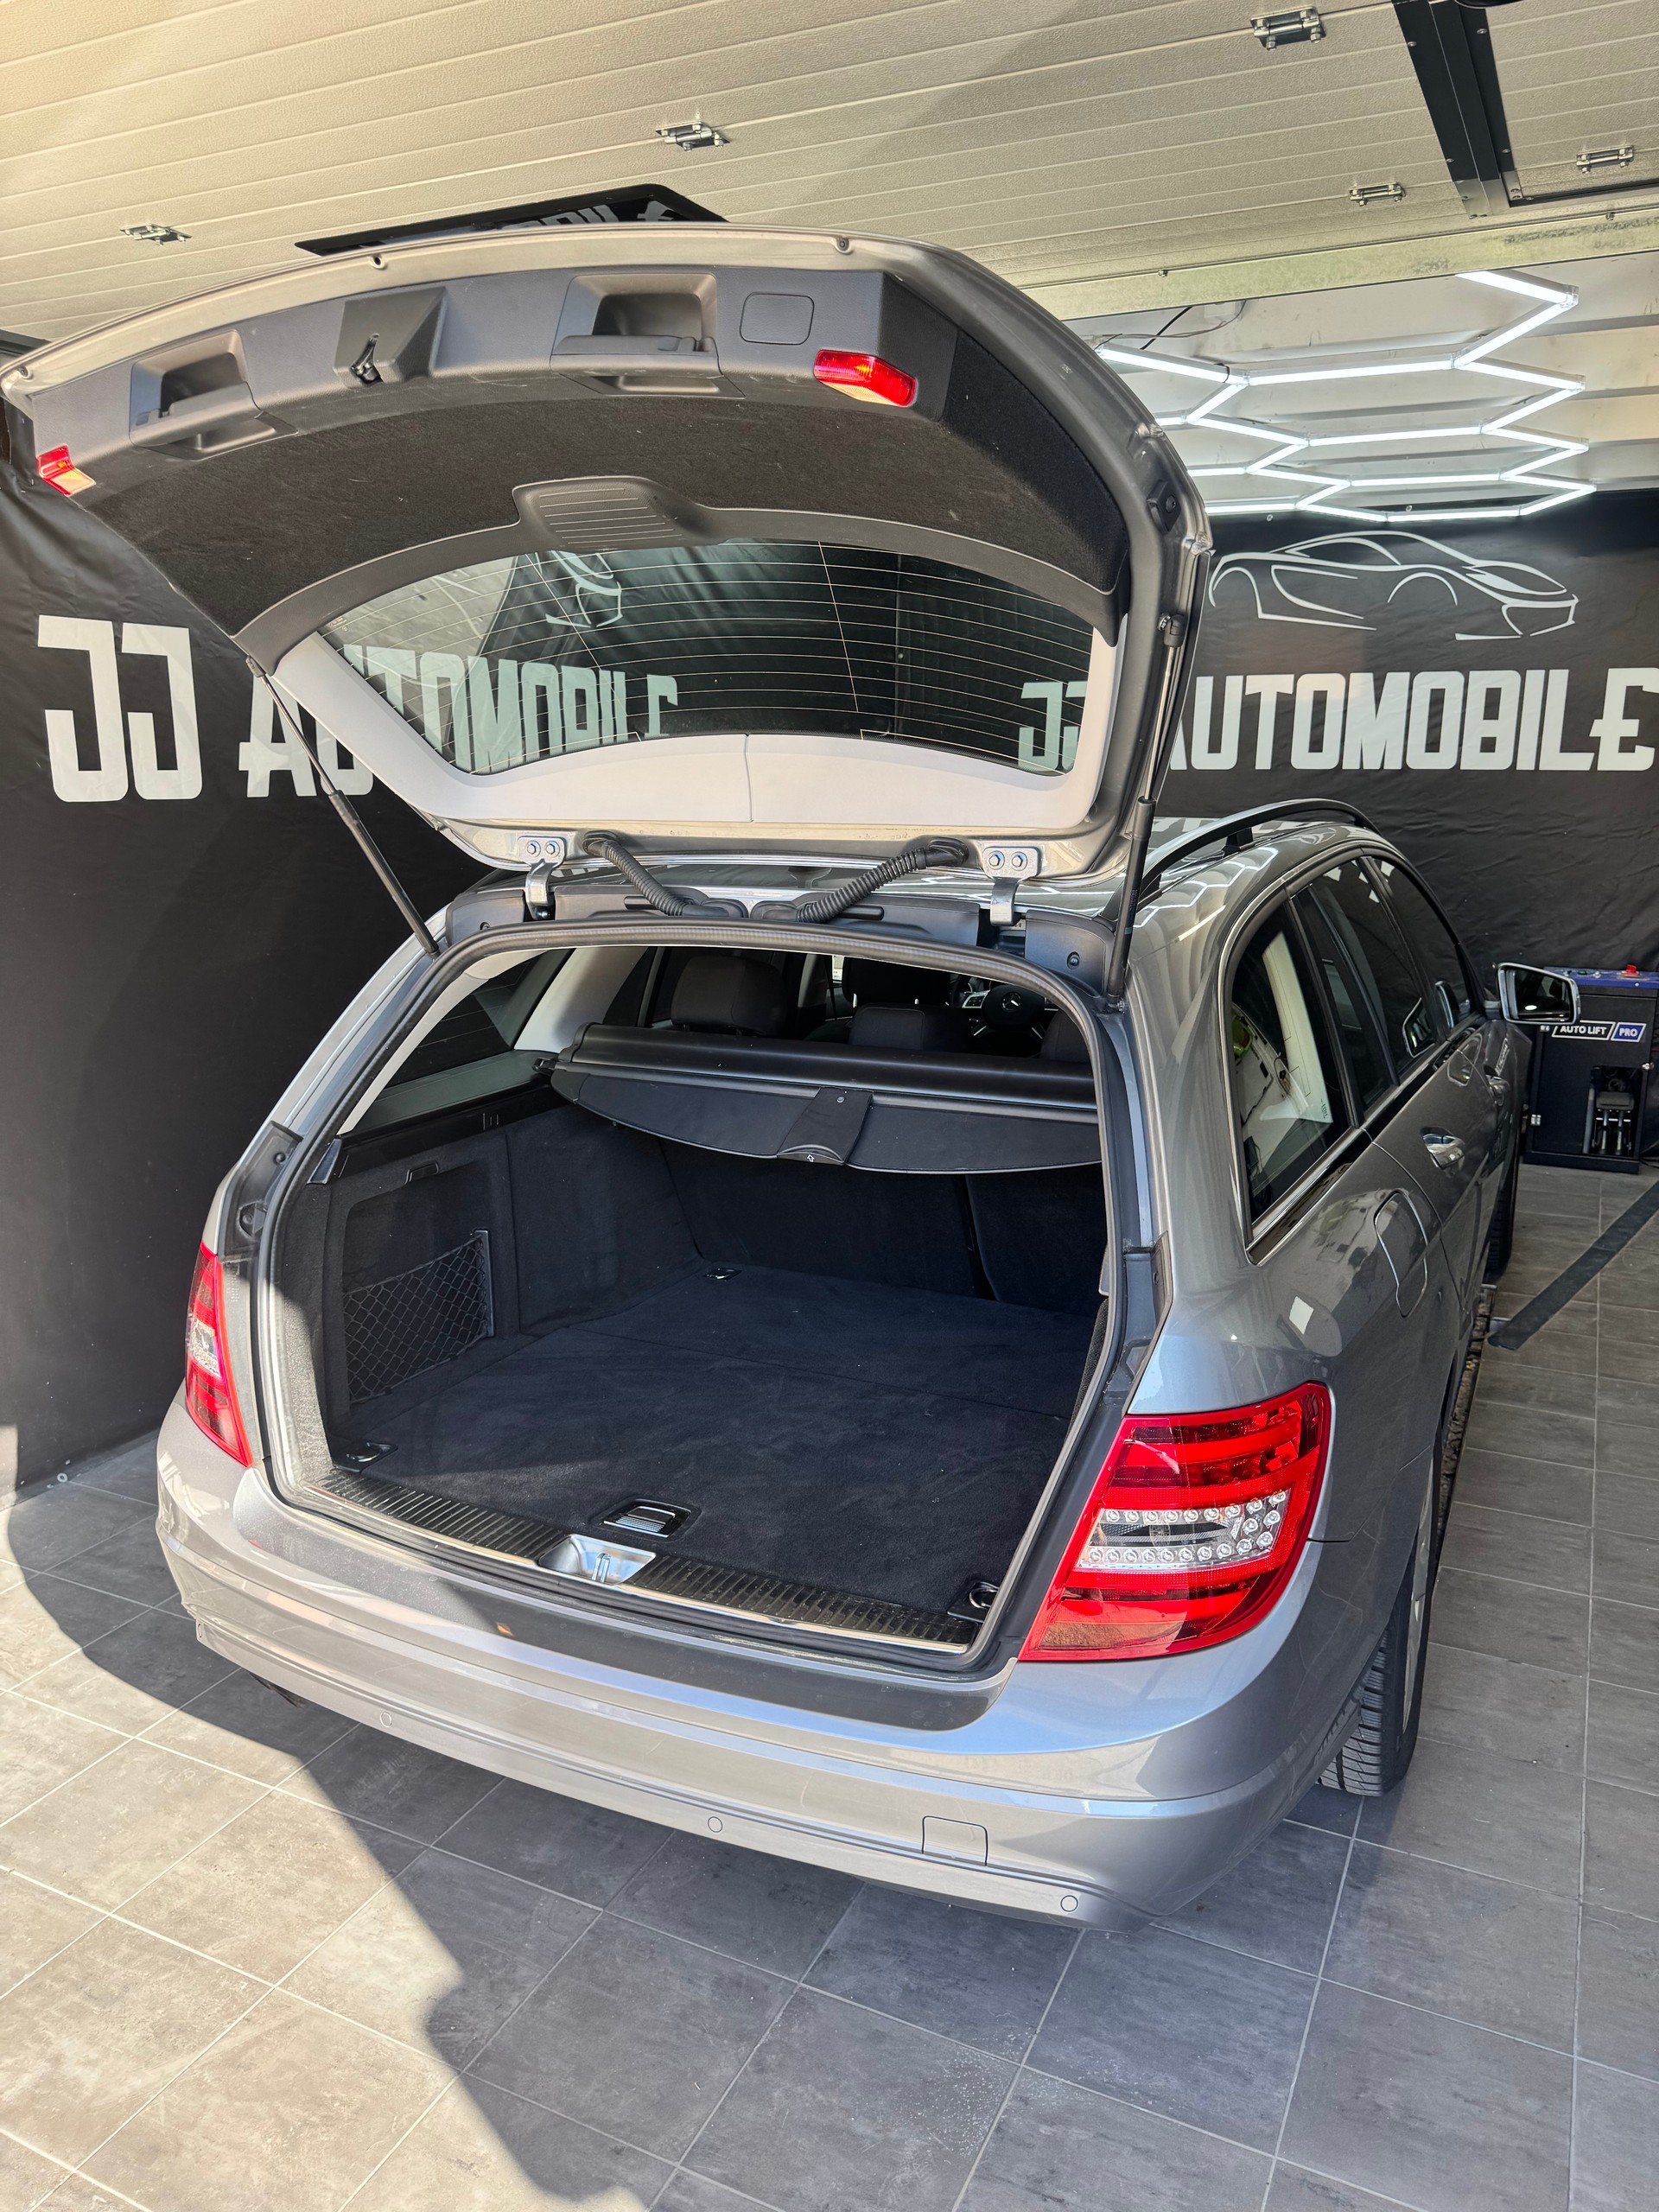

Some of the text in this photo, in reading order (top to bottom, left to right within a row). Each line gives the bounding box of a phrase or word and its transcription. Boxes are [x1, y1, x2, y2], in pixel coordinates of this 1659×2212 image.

[38, 614, 202, 802] JJ
[1170, 667, 1659, 772] UTOMOBILE
[1560, 1025, 1638, 1037] AUTO LIFT PRO
